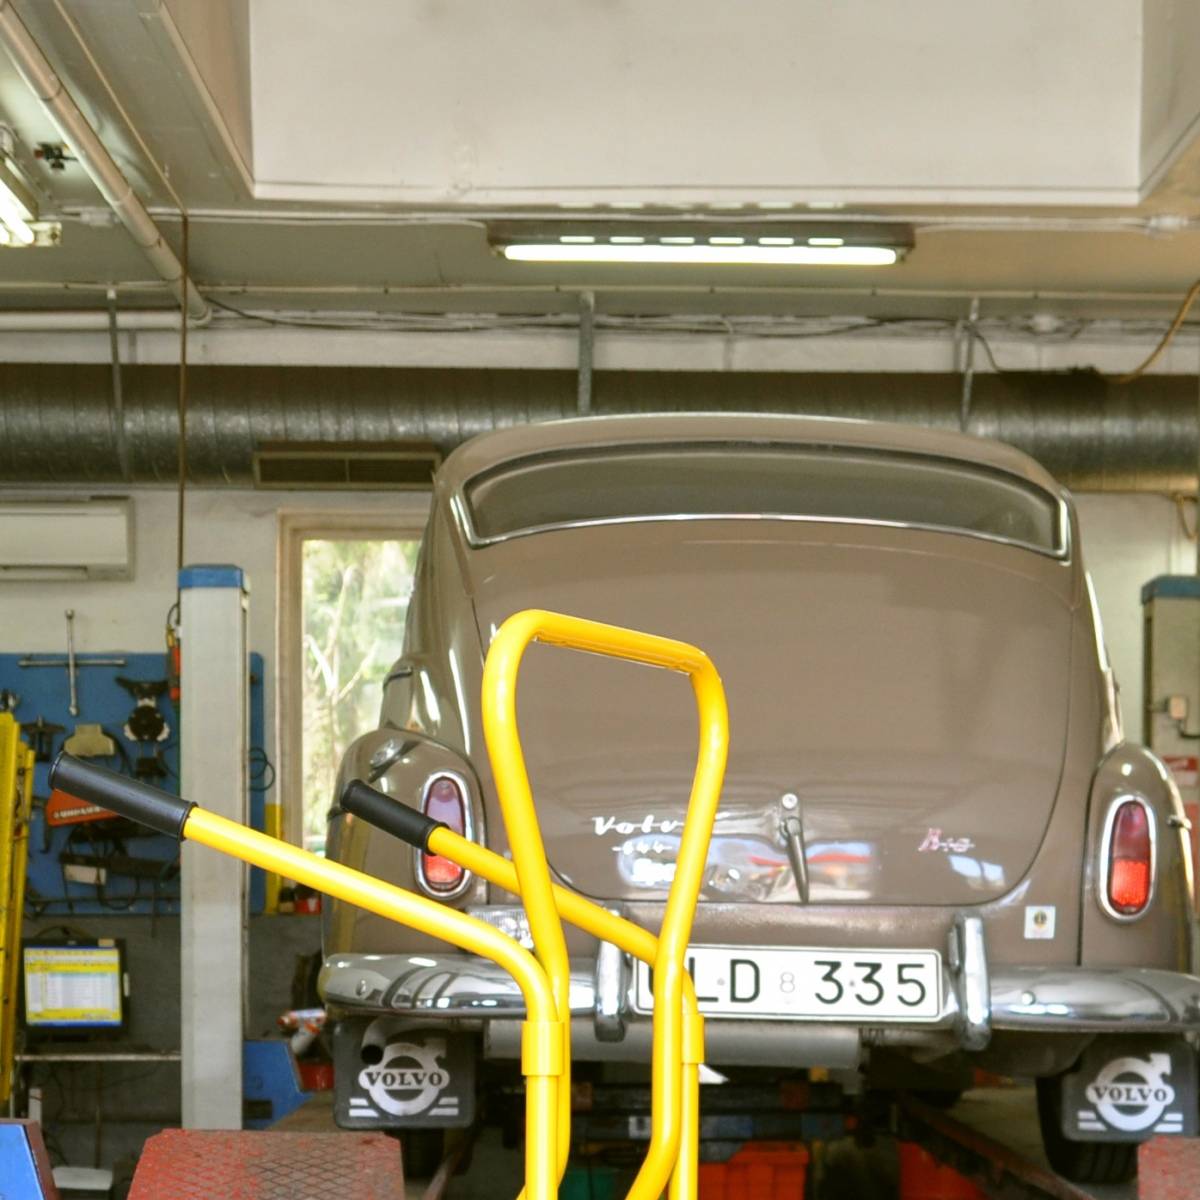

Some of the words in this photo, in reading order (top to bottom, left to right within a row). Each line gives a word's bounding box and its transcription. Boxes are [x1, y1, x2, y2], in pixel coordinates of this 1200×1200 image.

[592, 814, 684, 836] Volv
[648, 956, 761, 1003] LD
[814, 960, 926, 1006] 335
[365, 1071, 443, 1088] VOLVO
[1093, 1086, 1168, 1102] VOLVO
